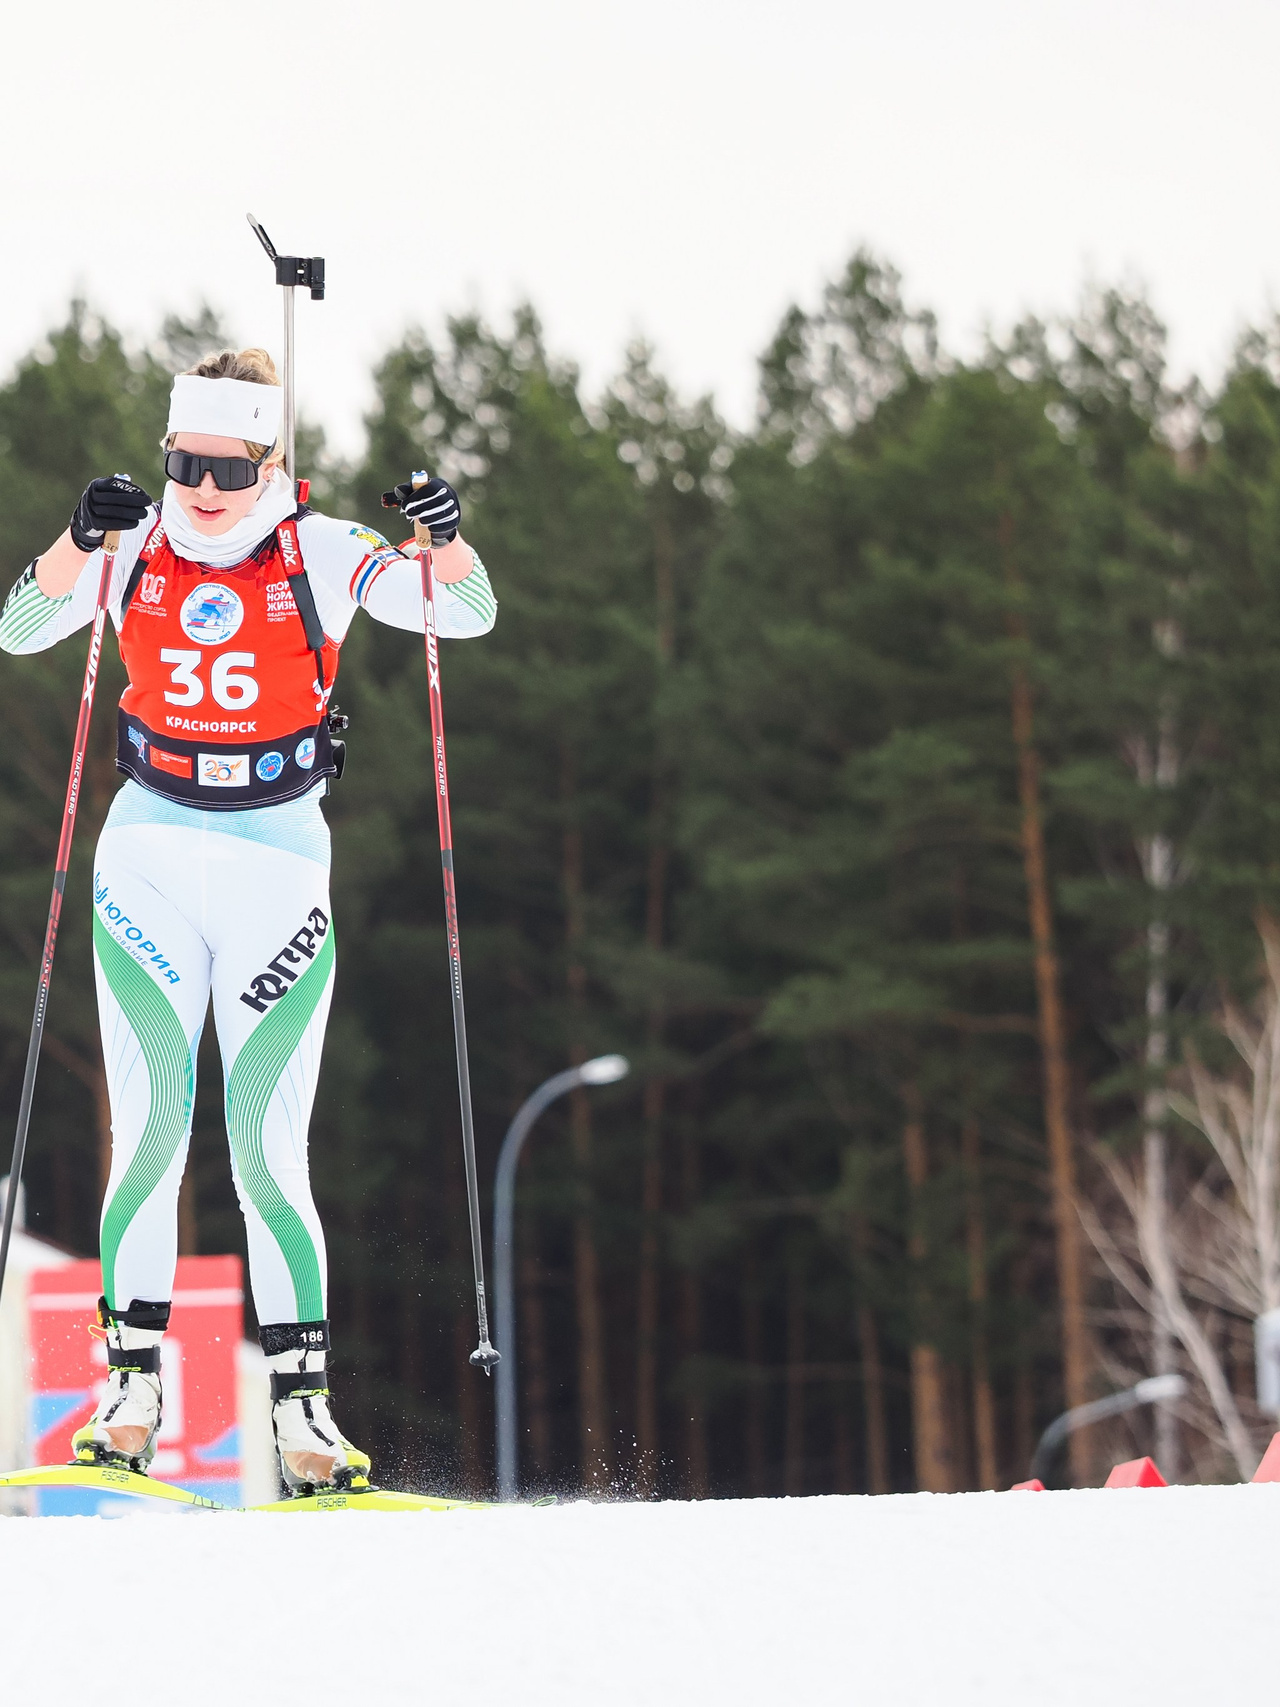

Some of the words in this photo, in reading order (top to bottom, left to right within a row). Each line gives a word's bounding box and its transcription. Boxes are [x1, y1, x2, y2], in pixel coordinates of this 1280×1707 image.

[266, 581, 290, 592] СПОР
[267, 600, 297, 612] ЖИЗН
[160, 648, 259, 711] 36
[165, 716, 257, 733] КРАСНОЯРСК
[104, 901, 181, 984] ЮГОРИЯ
[300, 1330, 324, 1343] 186
[317, 1497, 347, 1508] FISCHER
